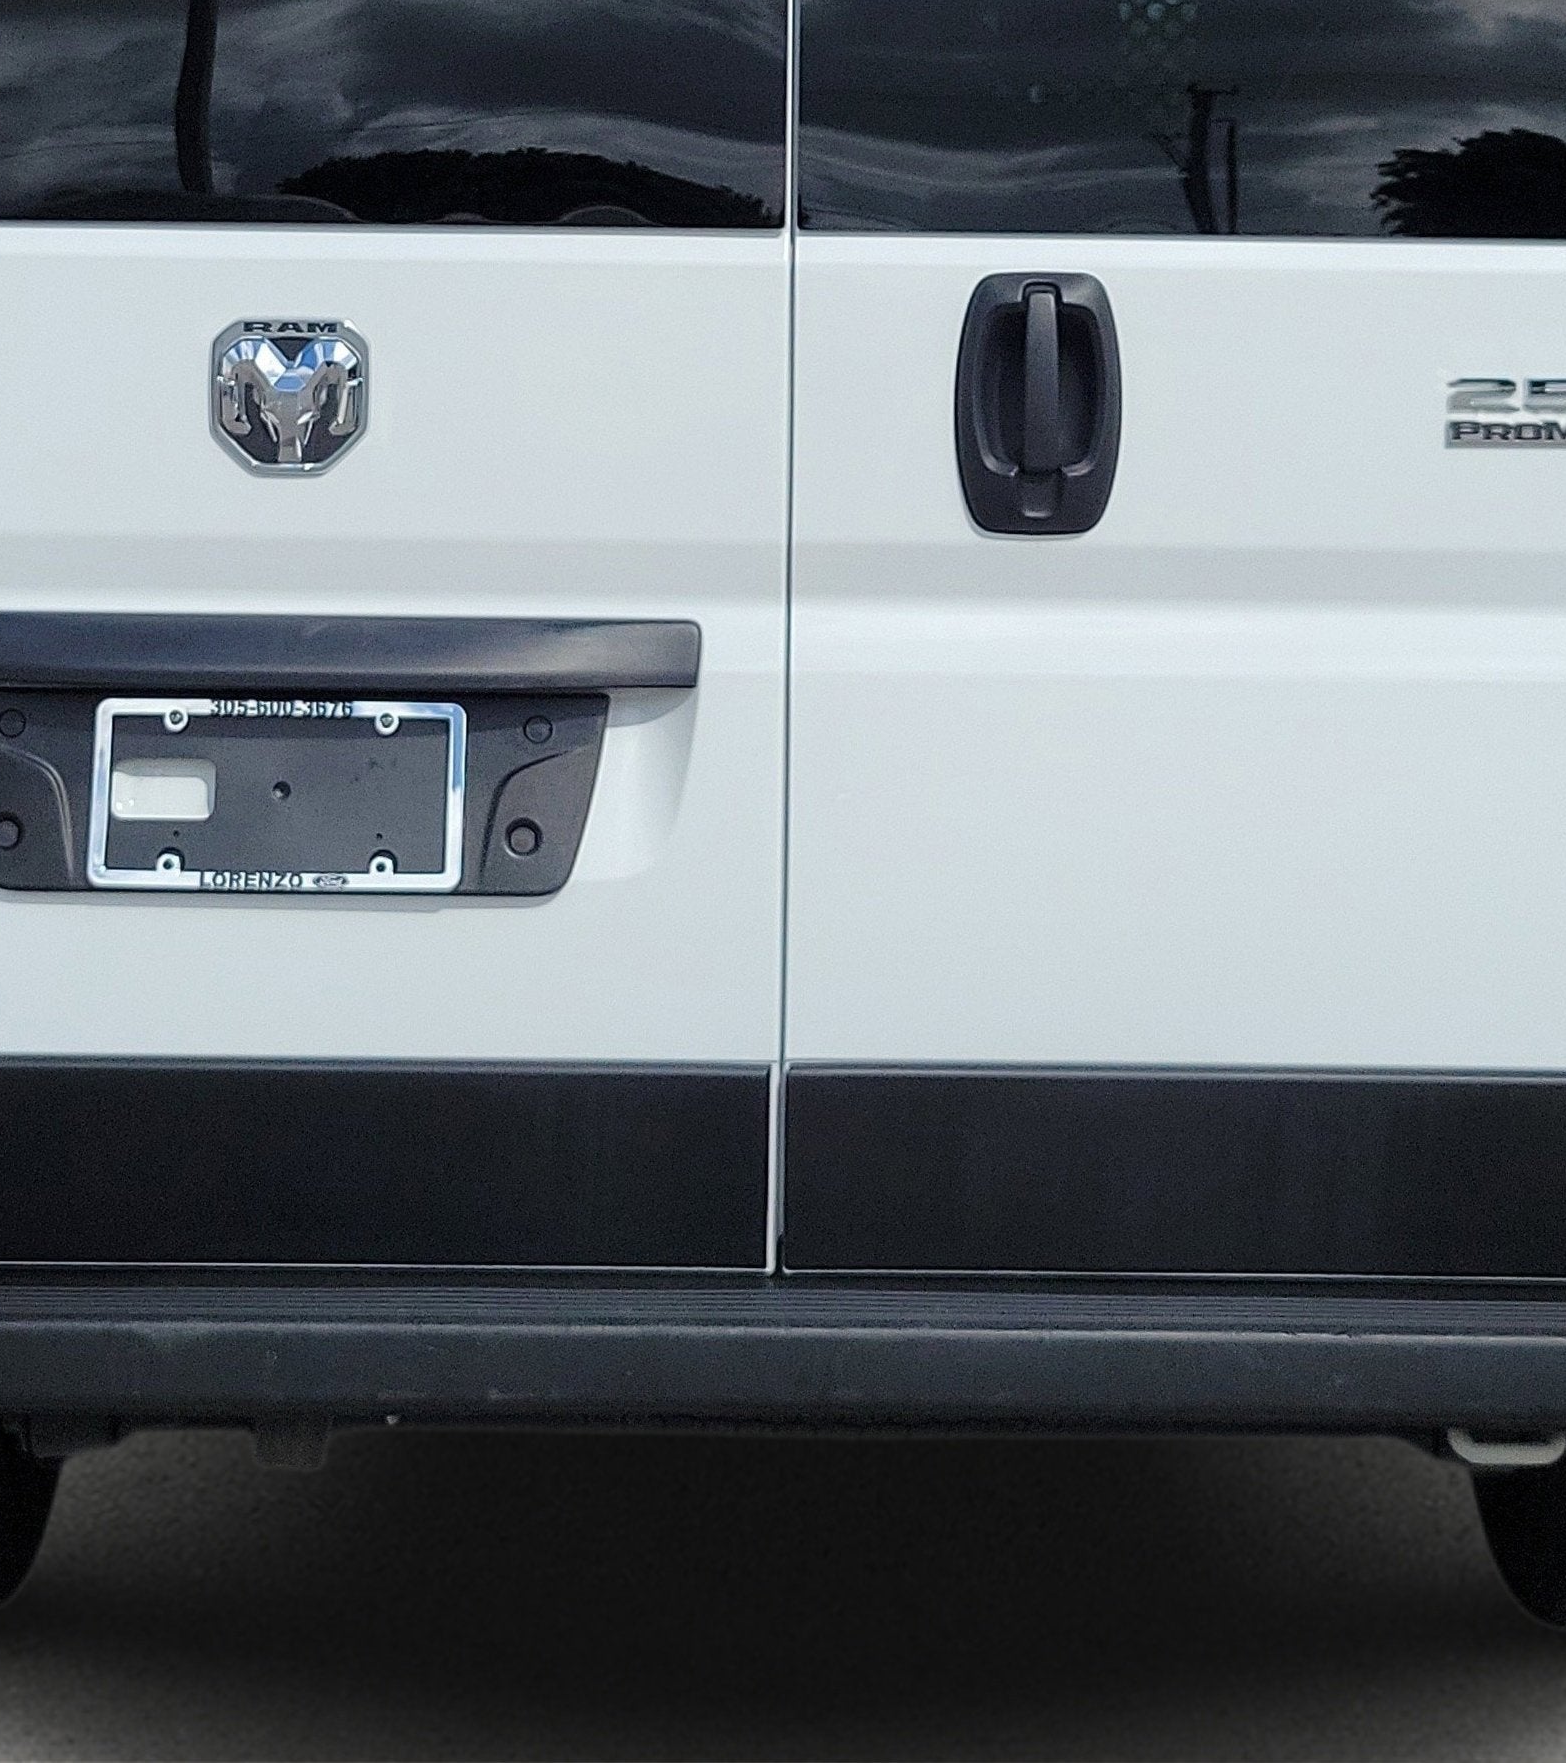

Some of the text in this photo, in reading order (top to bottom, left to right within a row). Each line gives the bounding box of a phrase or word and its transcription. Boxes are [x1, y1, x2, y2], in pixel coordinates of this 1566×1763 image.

[243, 321, 338, 333] RAM
[209, 700, 354, 718] 305-600-3676
[199, 870, 303, 888] LORENZO
